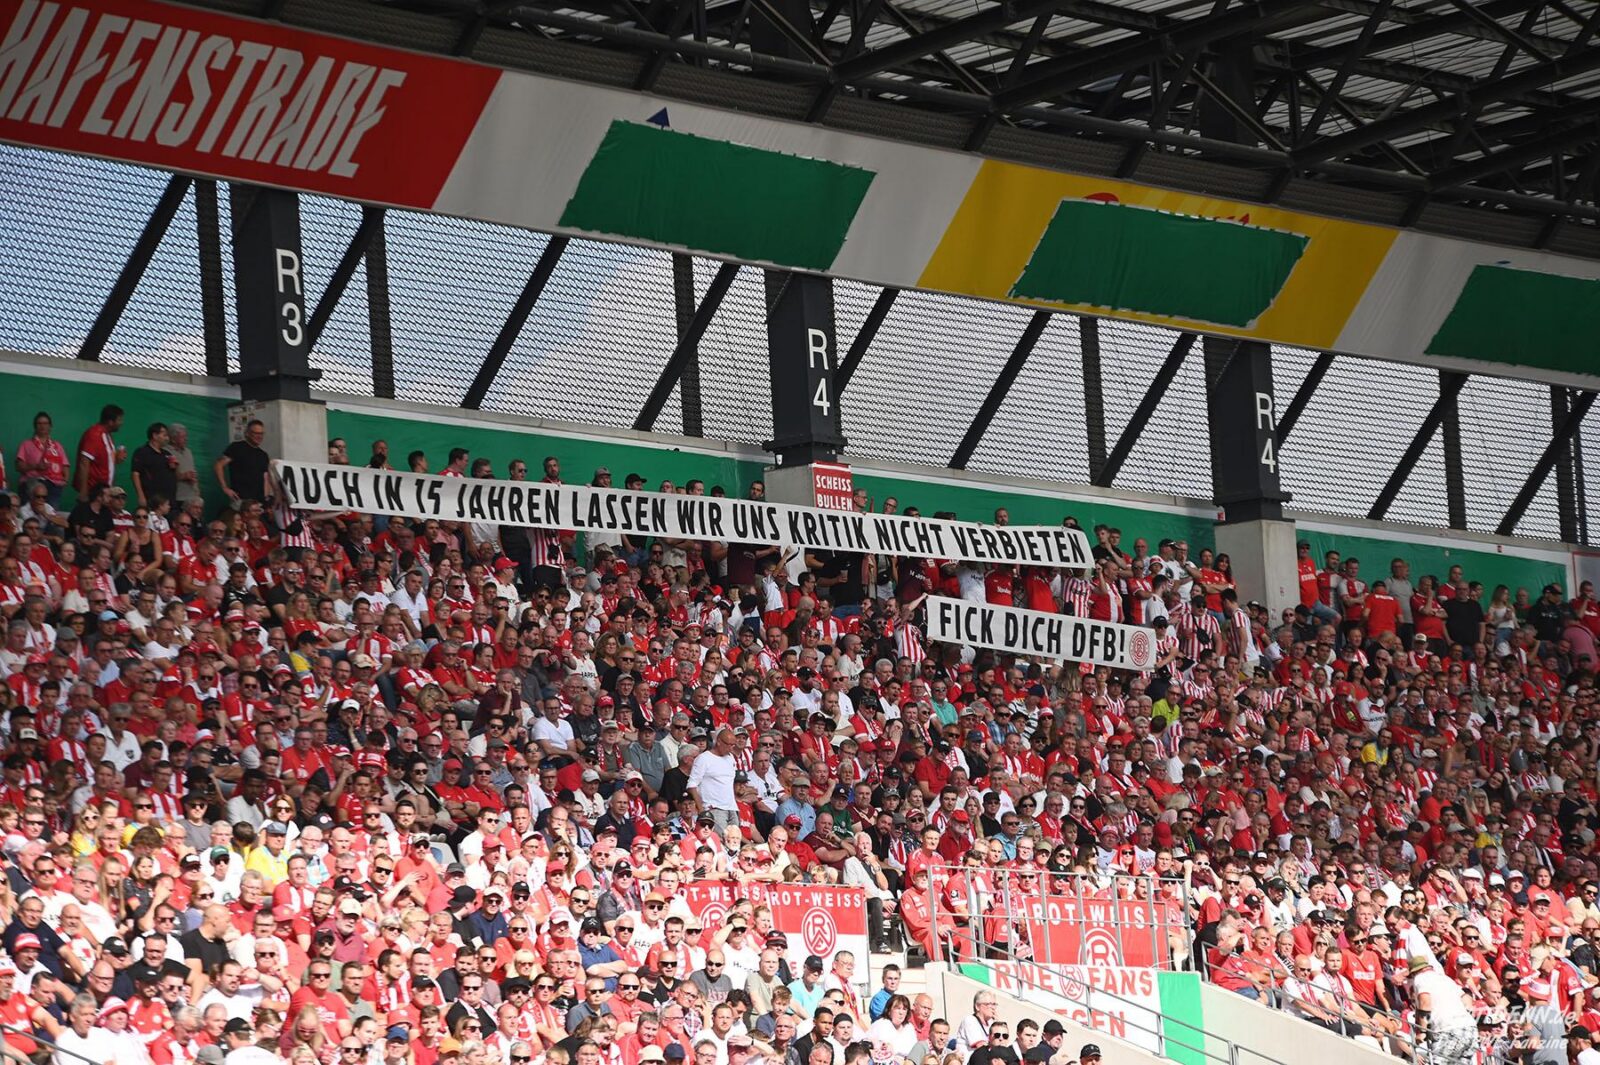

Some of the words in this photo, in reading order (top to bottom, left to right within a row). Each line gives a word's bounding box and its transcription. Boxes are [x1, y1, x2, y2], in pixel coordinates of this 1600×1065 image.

[816, 474, 852, 492] SCHEISS
[817, 493, 853, 511] BULLEN
[282, 465, 364, 508] AUCH
[373, 474, 405, 512] IN
[414, 478, 444, 515] 15
[456, 483, 561, 525] JAHREN
[572, 491, 668, 533] LASSEN
[677, 499, 725, 537] WIR
[732, 503, 780, 541] UNS
[788, 510, 870, 549] KRITIK
[873, 518, 946, 556] NICHT
[950, 525, 1086, 563] VERBIETEN
[939, 602, 994, 645] FICK
[1004, 612, 1063, 654] DICH
[1072, 621, 1126, 663] DFB!
[677, 886, 761, 902] OT-WEISS
[770, 890, 862, 908] ROT-WEISS
[1087, 967, 1153, 997] FANS
